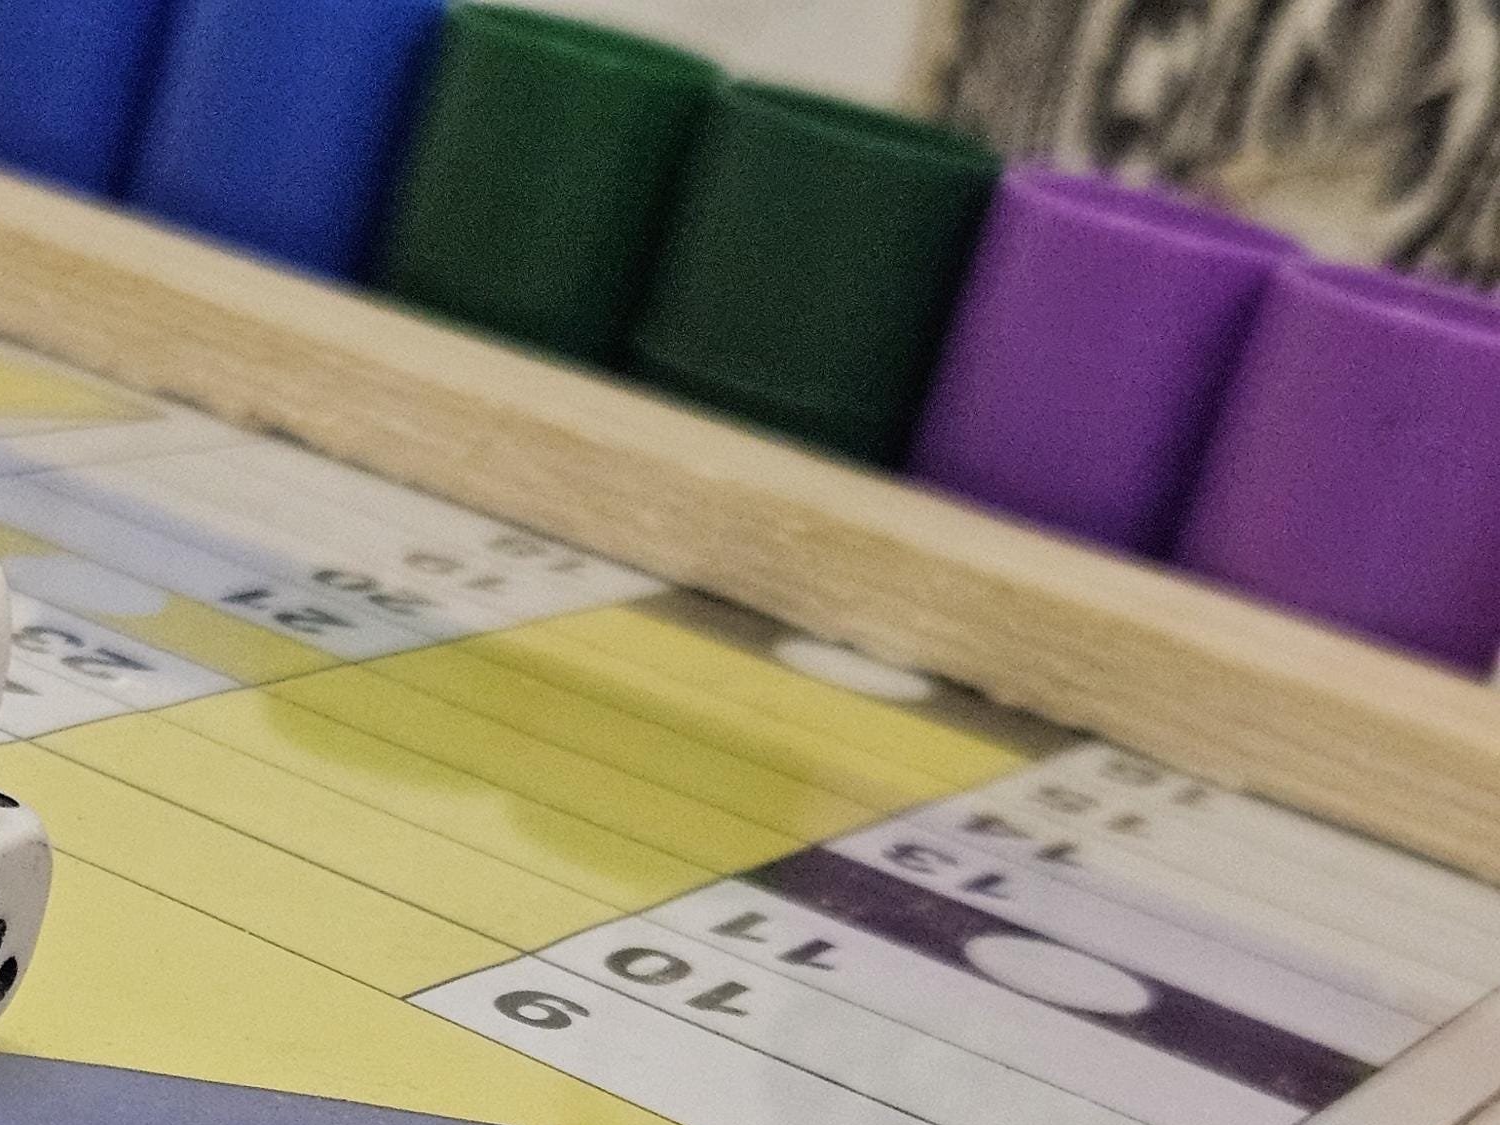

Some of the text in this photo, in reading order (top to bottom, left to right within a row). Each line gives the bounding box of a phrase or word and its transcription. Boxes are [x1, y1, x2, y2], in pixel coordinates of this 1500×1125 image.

[10, 625, 156, 680] 23
[880, 843, 1008, 900] 13
[709, 911, 836, 970] 11
[604, 946, 751, 1017] 10
